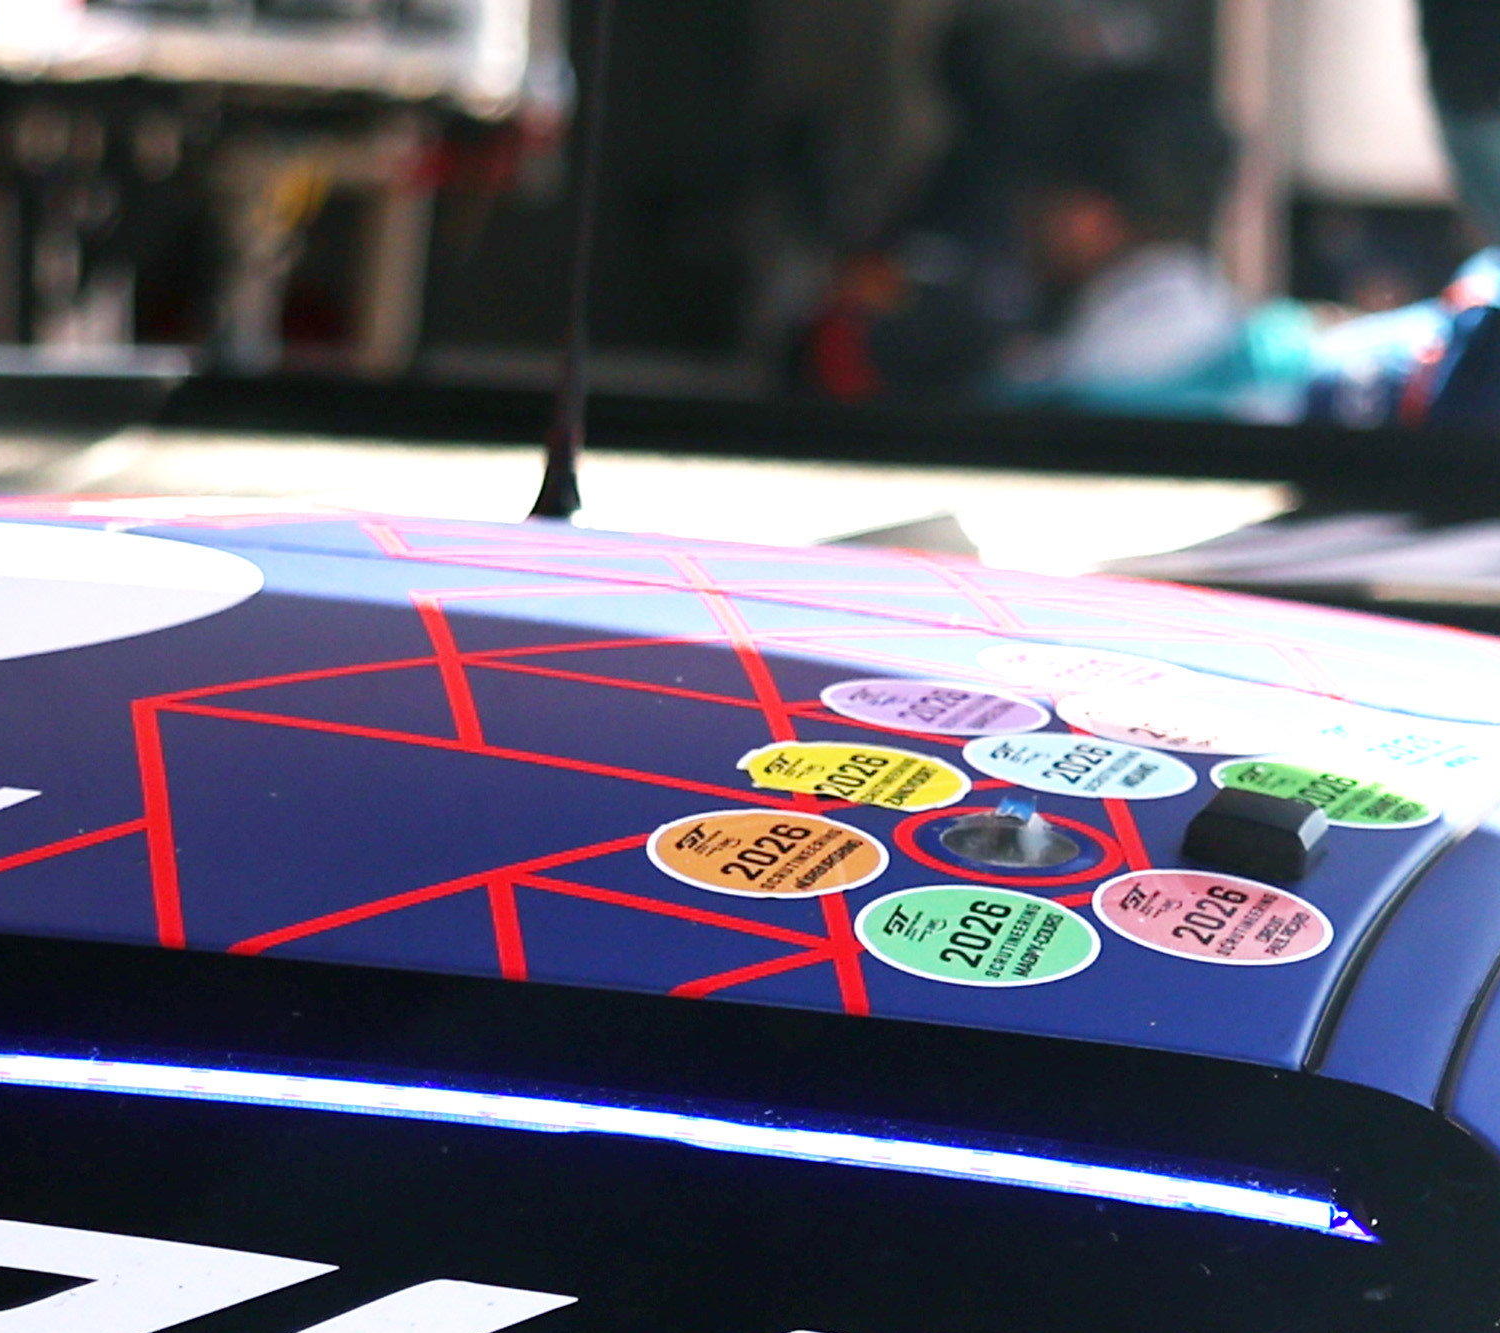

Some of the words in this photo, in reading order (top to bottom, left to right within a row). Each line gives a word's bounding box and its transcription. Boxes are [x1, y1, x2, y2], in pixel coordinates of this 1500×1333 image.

[814, 753, 890, 798] 2026
[1043, 743, 1114, 786] 2026
[720, 824, 813, 882] 2026
[883, 902, 912, 936] GT
[939, 899, 1014, 969] 2026
[1172, 885, 1251, 946] 2026
